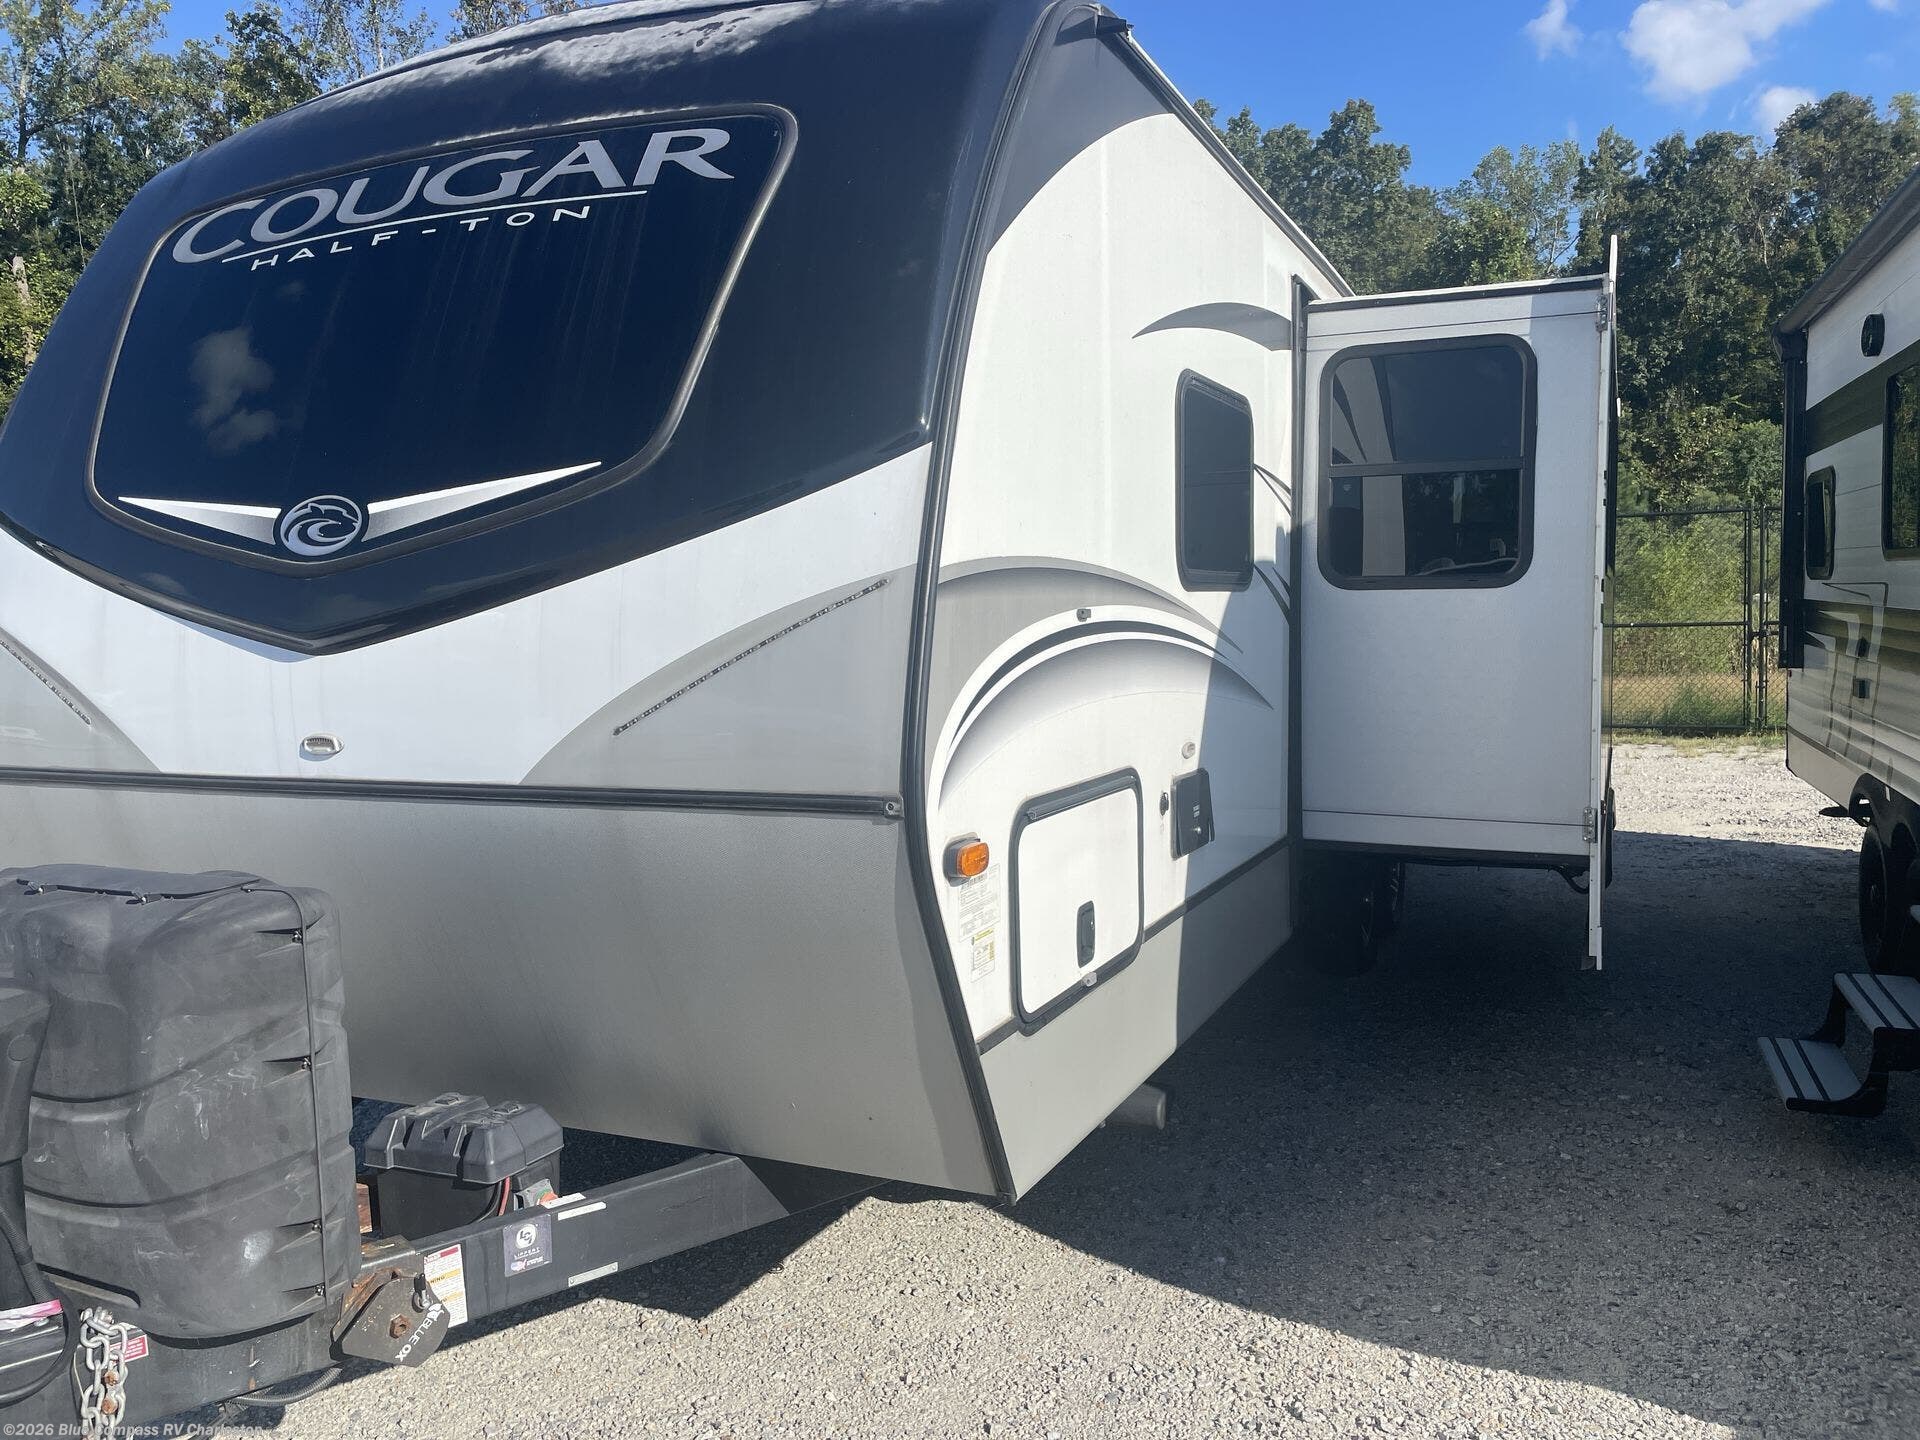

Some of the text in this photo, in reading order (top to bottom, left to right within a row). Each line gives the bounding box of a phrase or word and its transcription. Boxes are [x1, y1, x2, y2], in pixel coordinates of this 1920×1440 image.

[172, 128, 734, 264] COUGAR
[251, 205, 591, 271] HALF-TON
[395, 1317, 432, 1362] BLUE OX
